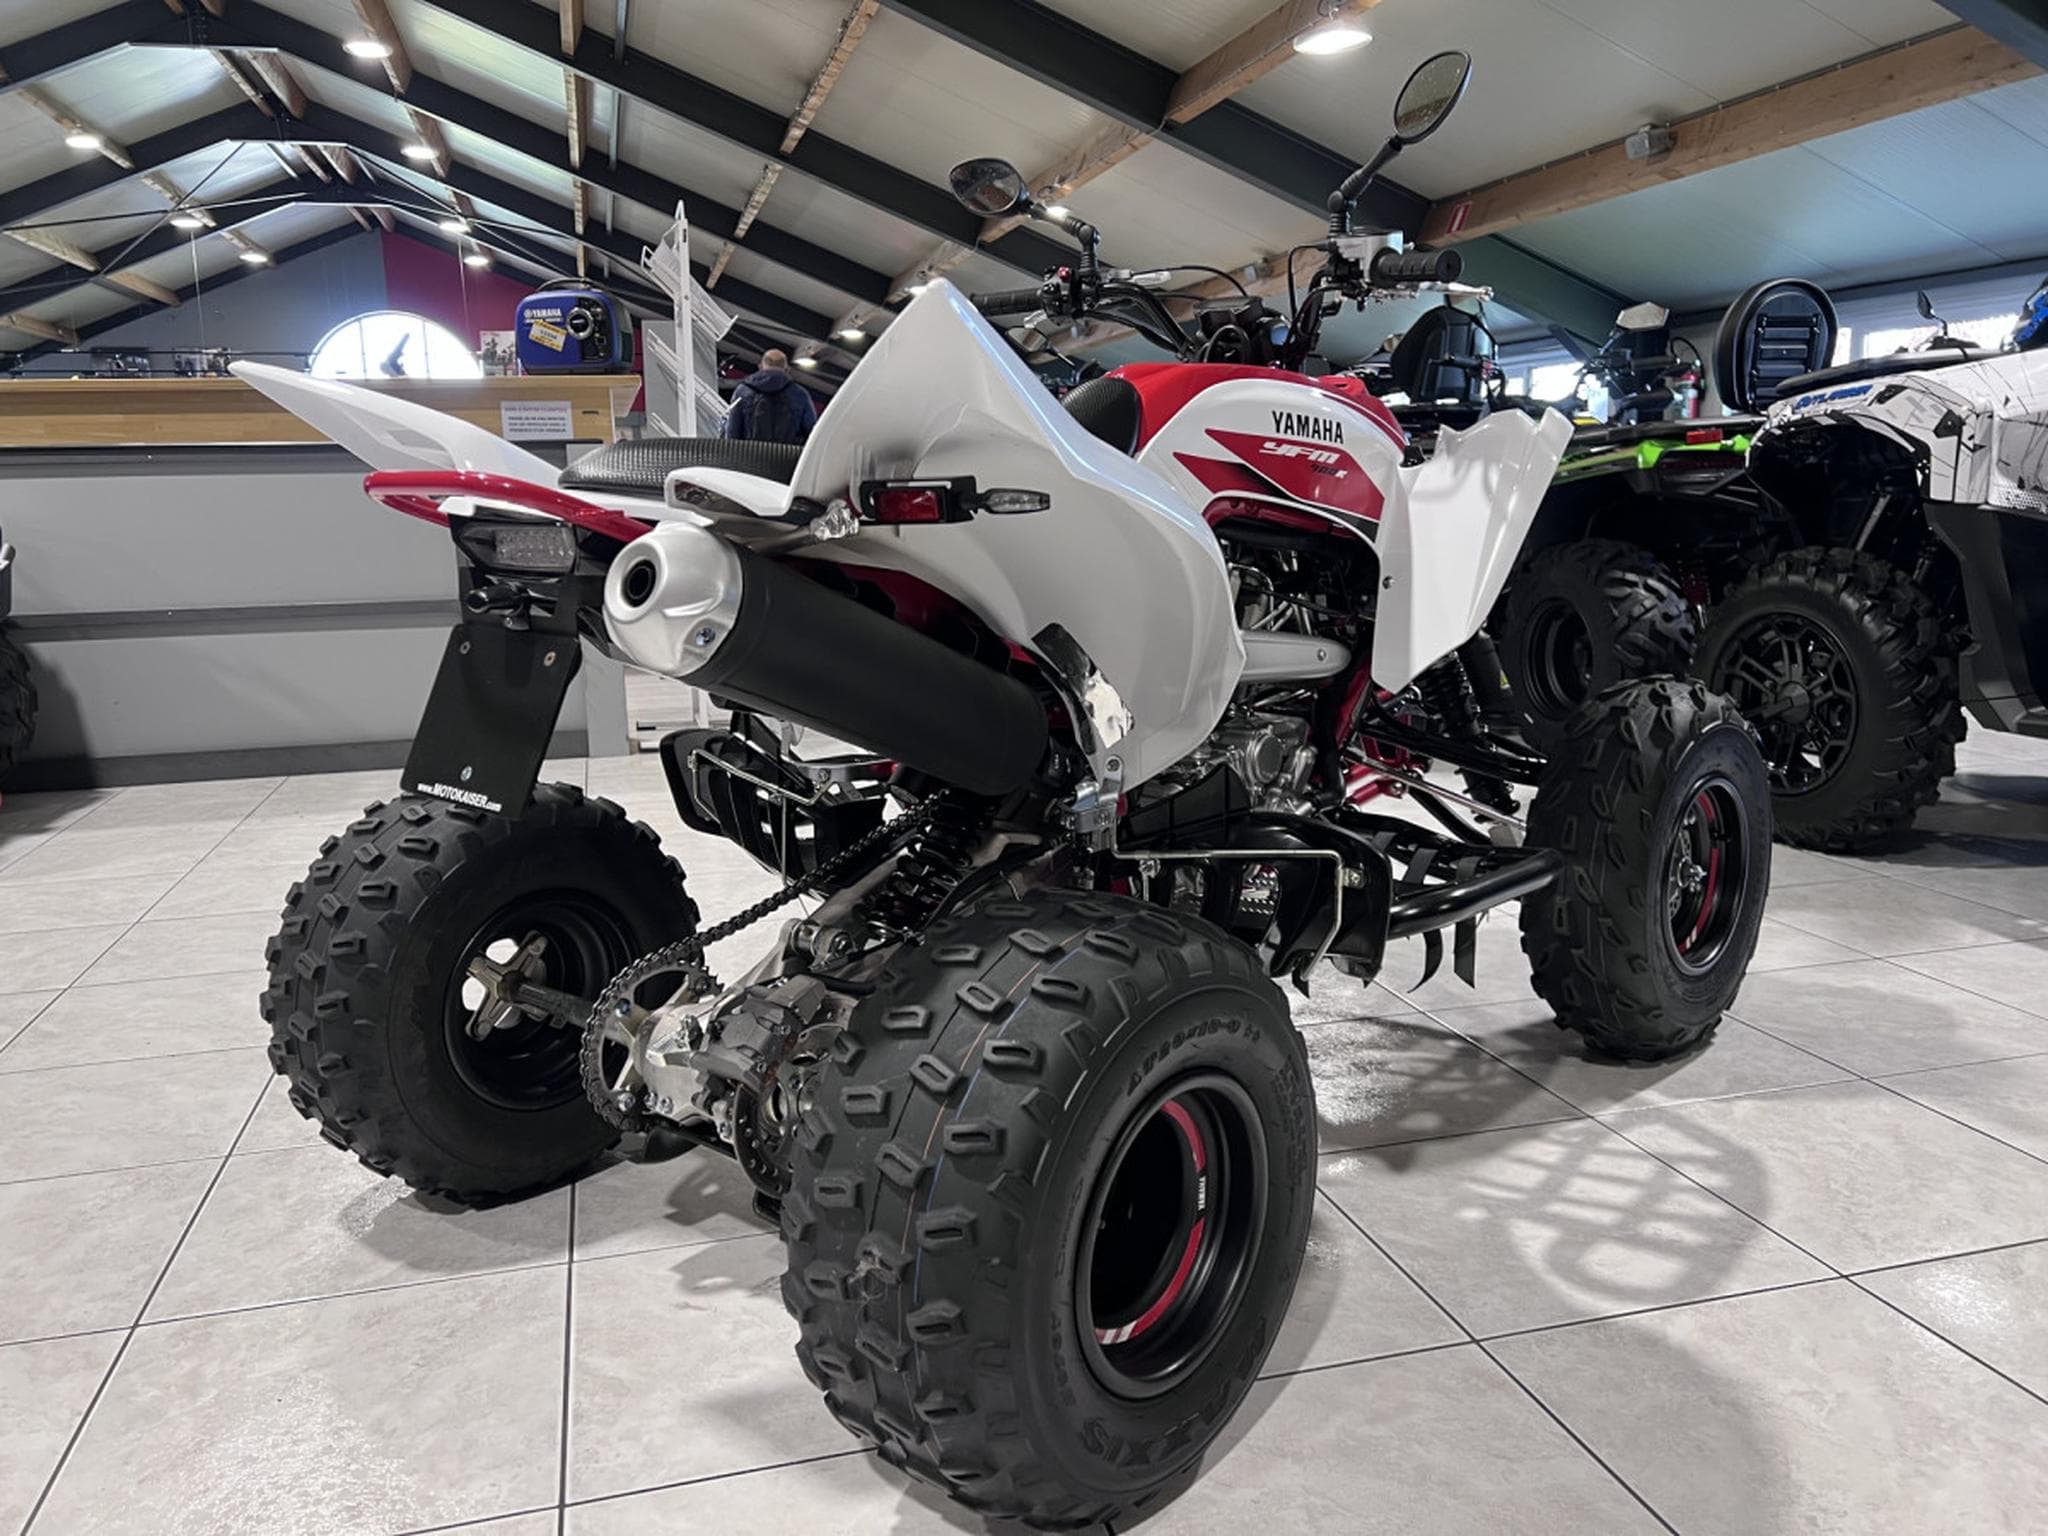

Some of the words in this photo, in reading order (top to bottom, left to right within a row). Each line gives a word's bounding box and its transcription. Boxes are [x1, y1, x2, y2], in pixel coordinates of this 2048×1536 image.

[533, 308, 562, 317] YAMAHA
[1272, 410, 1344, 444] YAMAHA
[1260, 442, 1340, 463] YFM
[417, 783, 502, 812] www.MOTOKAISER.com
